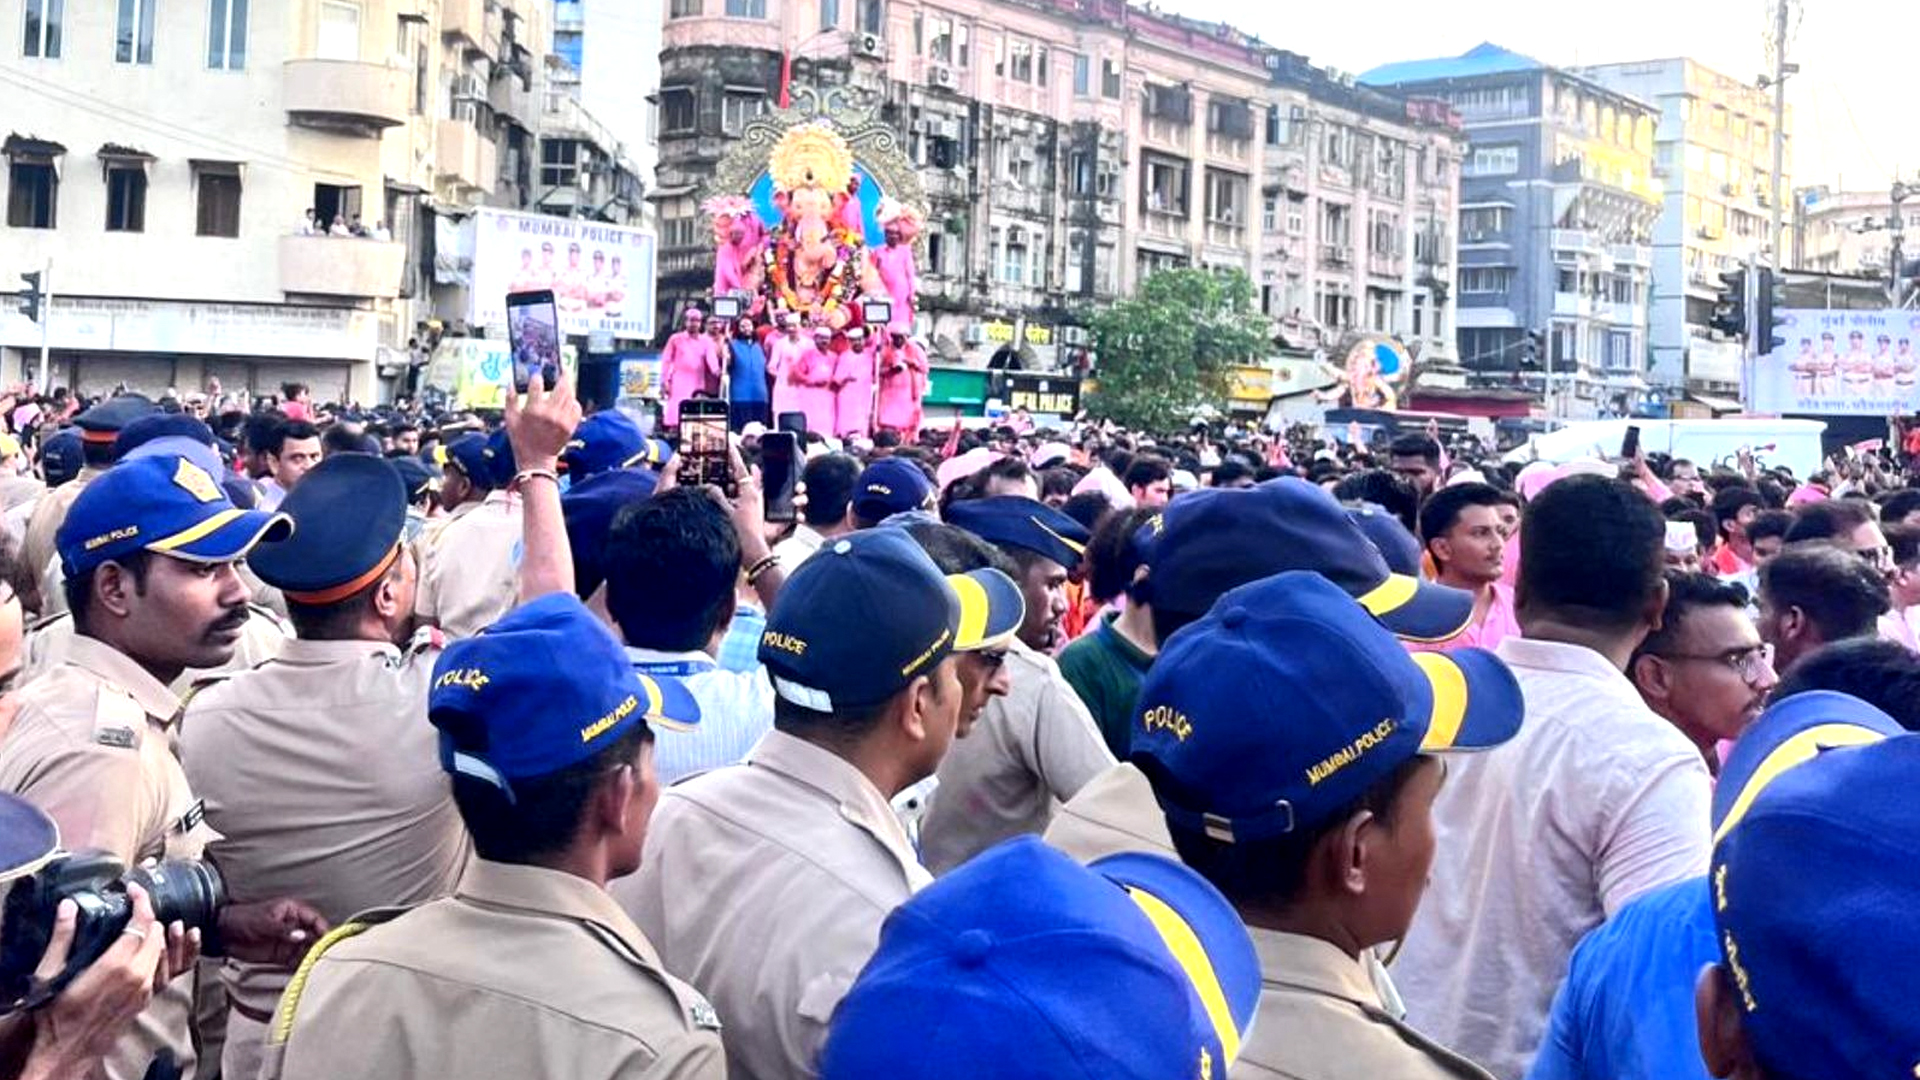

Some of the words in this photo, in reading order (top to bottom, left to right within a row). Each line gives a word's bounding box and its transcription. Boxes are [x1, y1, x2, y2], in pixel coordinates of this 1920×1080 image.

[519, 220, 577, 239] MUMBAI
[581, 226, 624, 245] POLICE
[110, 525, 139, 541] POLICE
[763, 631, 808, 655] POLICE
[434, 668, 490, 691] POLICE
[581, 712, 616, 743] MUMBAI
[613, 694, 638, 722] POLICE
[1144, 705, 1193, 742] POLICE
[1305, 744, 1357, 787] MUMBAI
[1355, 717, 1399, 756] POLICE
